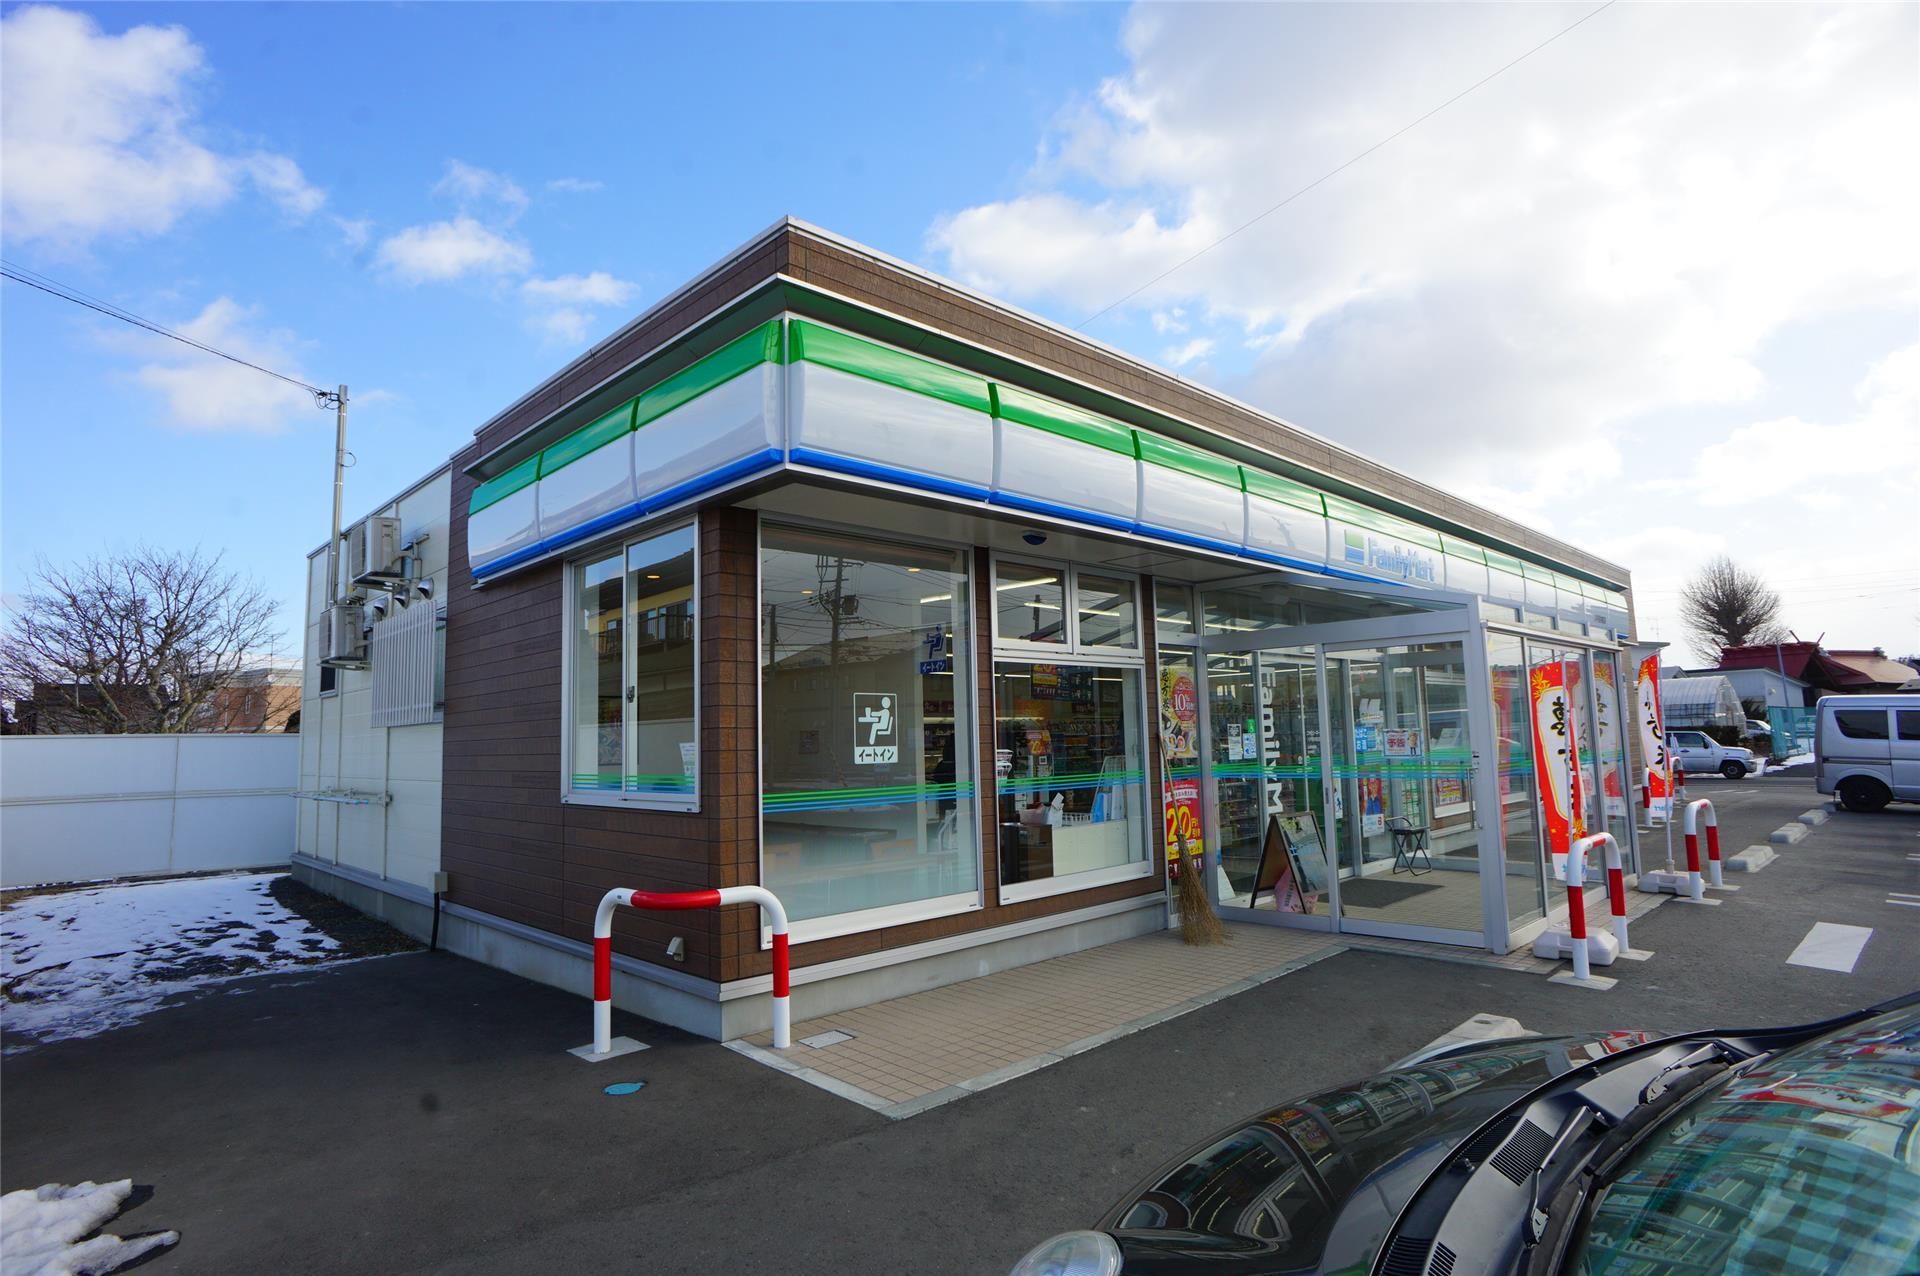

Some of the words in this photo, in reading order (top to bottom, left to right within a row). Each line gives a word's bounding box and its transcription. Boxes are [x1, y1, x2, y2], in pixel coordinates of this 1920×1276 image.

[922, 661, 945, 673] イートイン
[1261, 667, 1283, 812] FamilyM
[858, 748, 895, 762] イートイン
